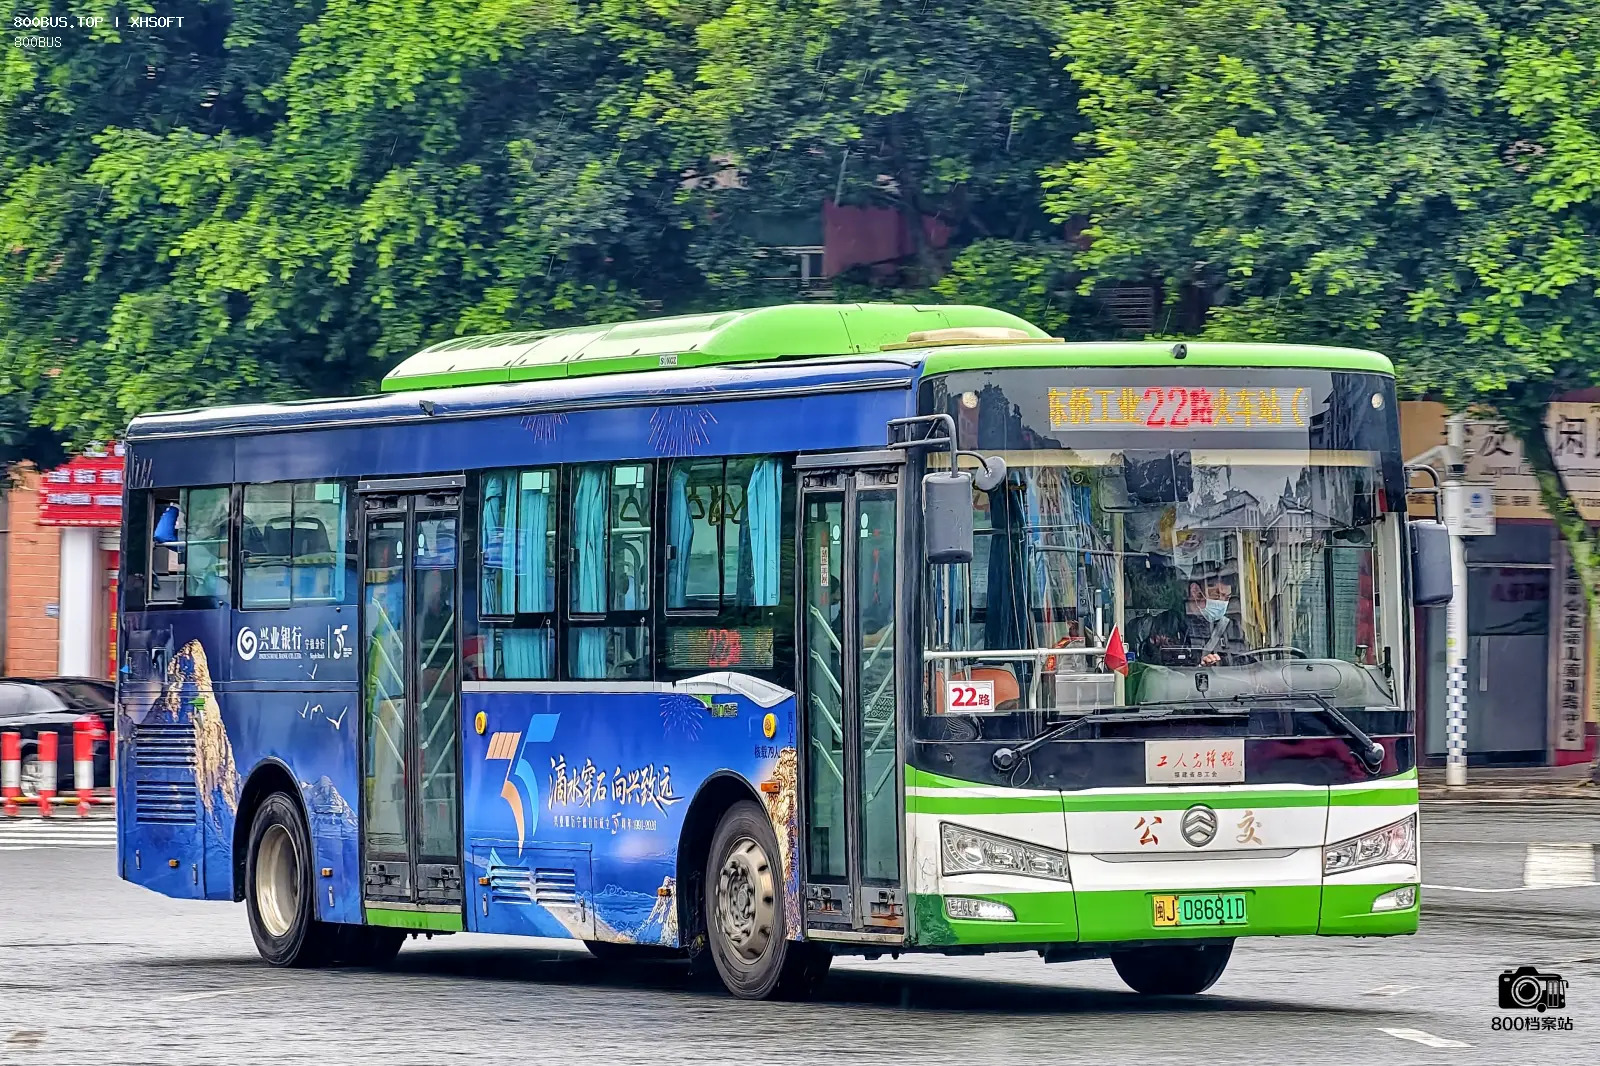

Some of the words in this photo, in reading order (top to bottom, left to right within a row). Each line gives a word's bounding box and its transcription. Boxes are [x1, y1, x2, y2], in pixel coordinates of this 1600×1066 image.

[259, 626, 302, 651] 兴业银行
[951, 687, 990, 707] 22路
[1134, 816, 1162, 846] 公
[1236, 810, 1262, 846] 交
